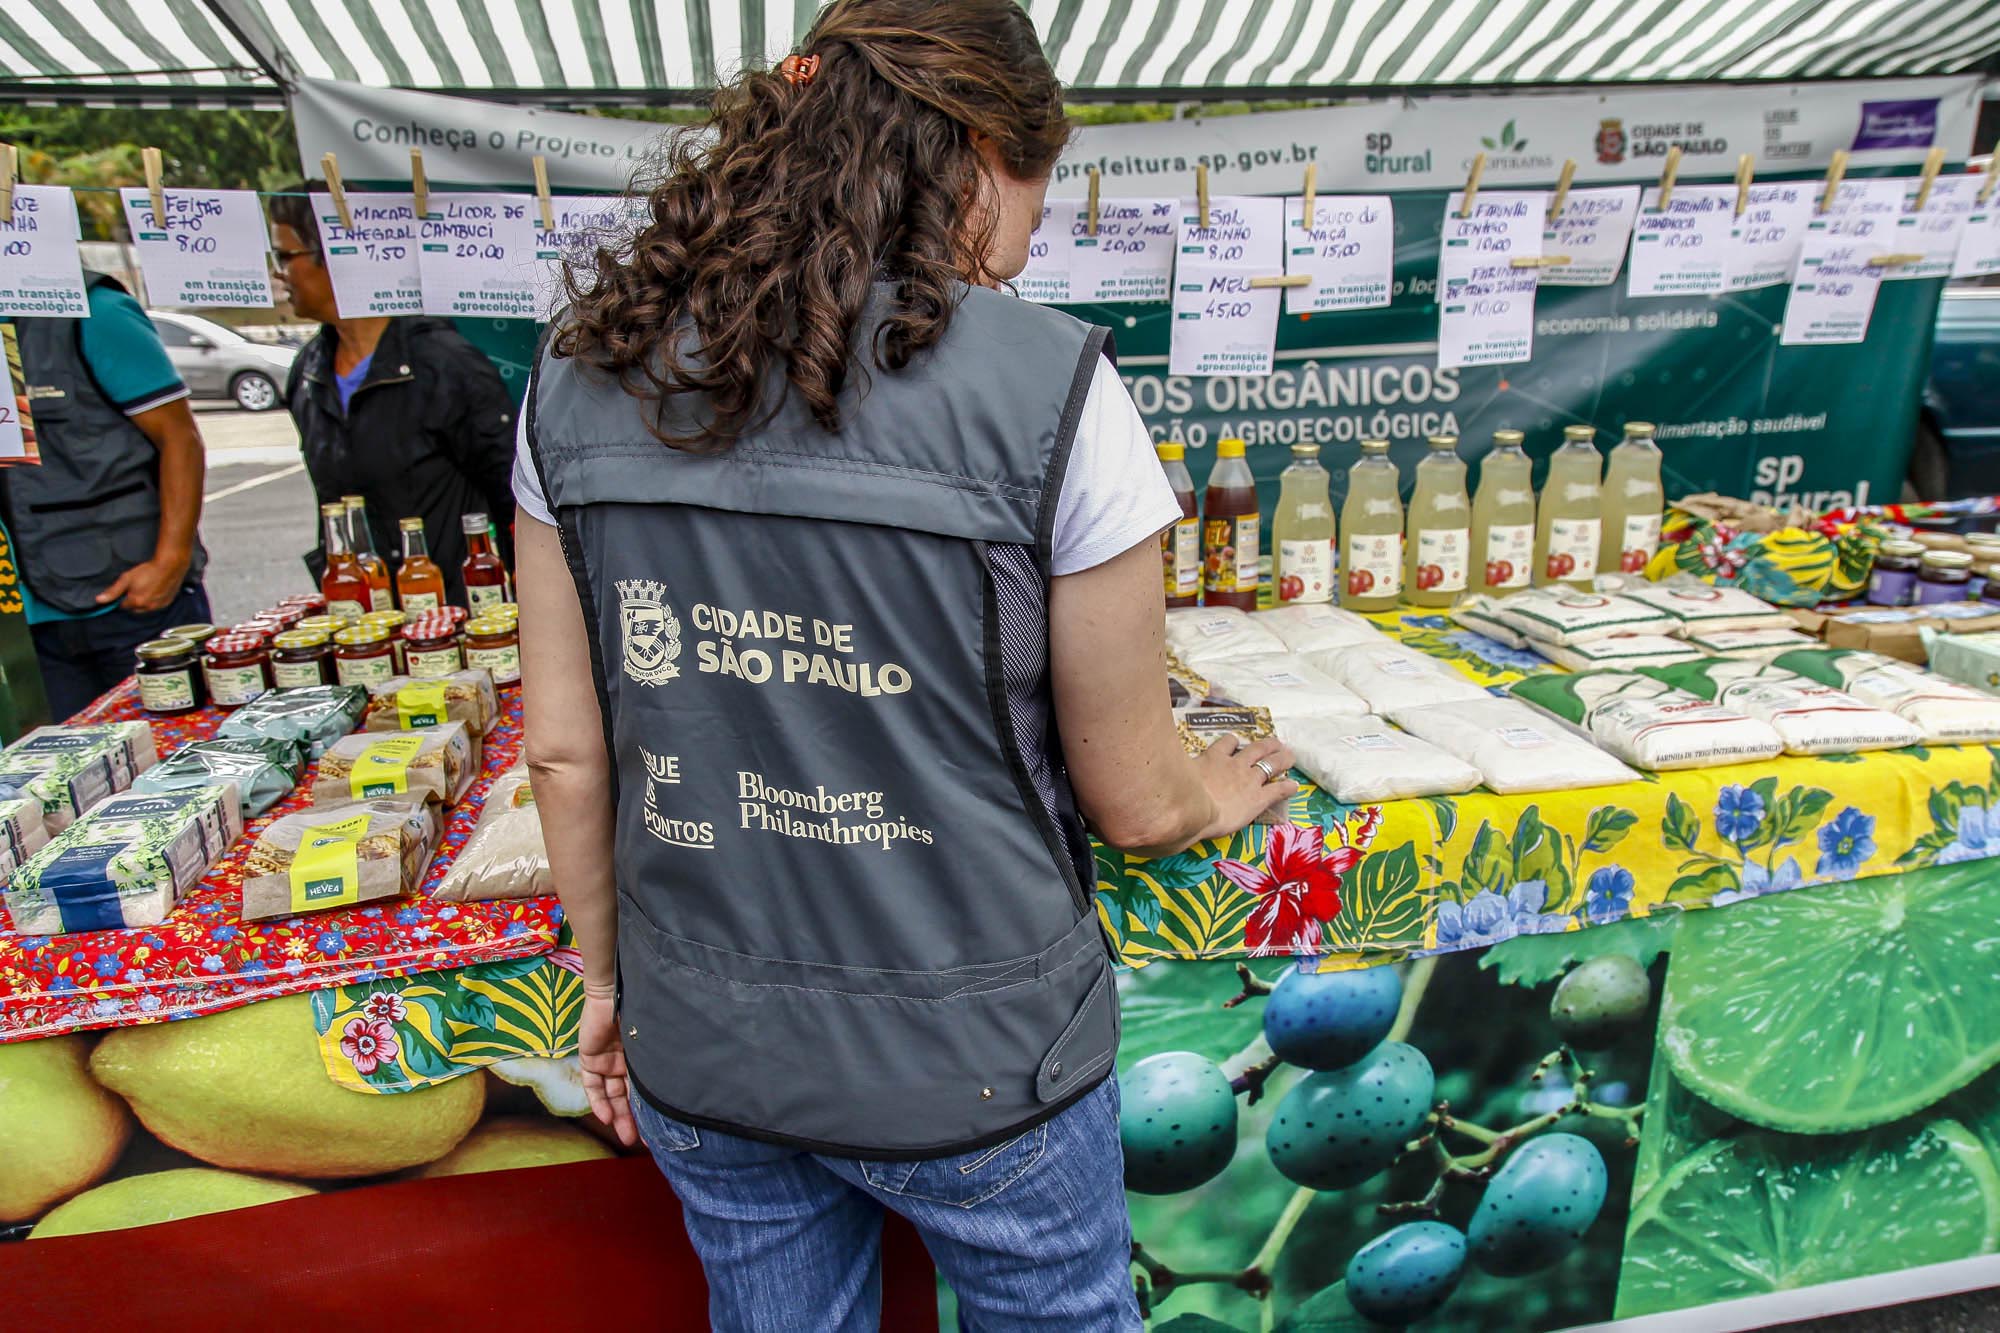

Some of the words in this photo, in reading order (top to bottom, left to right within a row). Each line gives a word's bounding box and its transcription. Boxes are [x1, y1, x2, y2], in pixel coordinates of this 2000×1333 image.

[353, 118, 477, 152] Conheça
[488, 131, 505, 150] o
[516, 131, 615, 159] Projeto
[1632, 124, 1679, 138] CIDADE
[1687, 122, 1704, 135] DE
[1366, 132, 1393, 153] sp
[1633, 140, 1665, 157] SÃO
[165, 195, 222, 218] FEIJÃO
[141, 213, 202, 231] PETO
[1209, 209, 1245, 226] SAL
[176, 234, 216, 252] 8,00
[455, 244, 504, 259] 20,00
[1322, 242, 1361, 258] 15,00
[364, 244, 406, 262] 7,50
[1208, 244, 1243, 261] 8,00
[185, 281, 203, 290] em
[207, 280, 266, 293] transição
[1119, 278, 1167, 289] transição
[1320, 287, 1336, 295] em
[1338, 282, 1386, 294] transição
[18, 289, 81, 304] transição
[180, 292, 267, 305] agroecológica
[374, 291, 393, 299] em
[458, 291, 477, 299] em
[480, 289, 534, 302] transição
[1095, 286, 1167, 299] agroecológica
[1314, 294, 1386, 306] agroecológica
[452, 300, 535, 314] agroecológica
[1205, 300, 1252, 319] 45,00
[1537, 314, 1631, 336] economia
[1635, 308, 1719, 331] solidária
[1486, 340, 1528, 351] transição
[1203, 353, 1219, 361] em
[1221, 352, 1268, 363] transição
[1196, 362, 1267, 373] agroecológica
[1206, 361, 1461, 412] ORGÂNICOS
[1220, 410, 1461, 445] AGROECOLÓGICA
[1653, 417, 1748, 440] limentação
[1751, 412, 1828, 434] saudável
[1754, 454, 1804, 493] sp
[692, 603, 805, 643] CIDADE
[813, 618, 854, 653] DE
[696, 638, 773, 684] SÃO
[783, 650, 912, 697] PAULO
[737, 771, 884, 818] Bloomberg
[644, 806, 714, 843] PONTOS
[738, 802, 934, 850] Philanthropies
[309, 884, 340, 896] HEVEA
